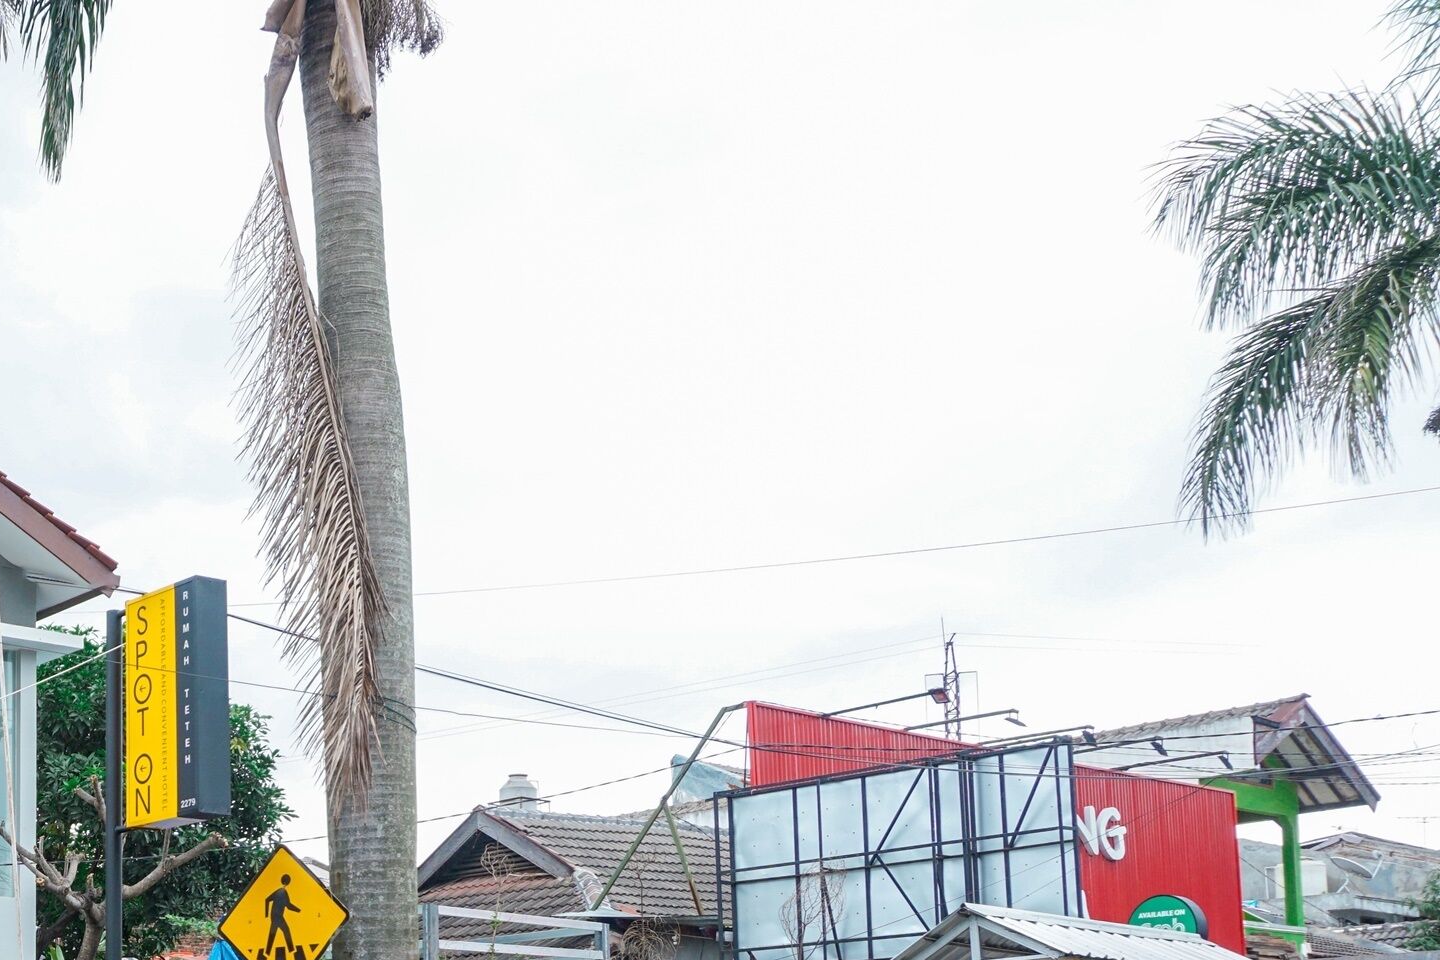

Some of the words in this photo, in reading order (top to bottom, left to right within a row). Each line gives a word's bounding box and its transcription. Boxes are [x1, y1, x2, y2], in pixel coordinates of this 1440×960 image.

[182, 590, 190, 667] RUMAH
[134, 605, 152, 737] SPOT
[184, 687, 192, 764] TETEH
[134, 753, 153, 817] ON
[180, 798, 197, 809] 2279
[1138, 910, 1173, 919] AVAILABLE
